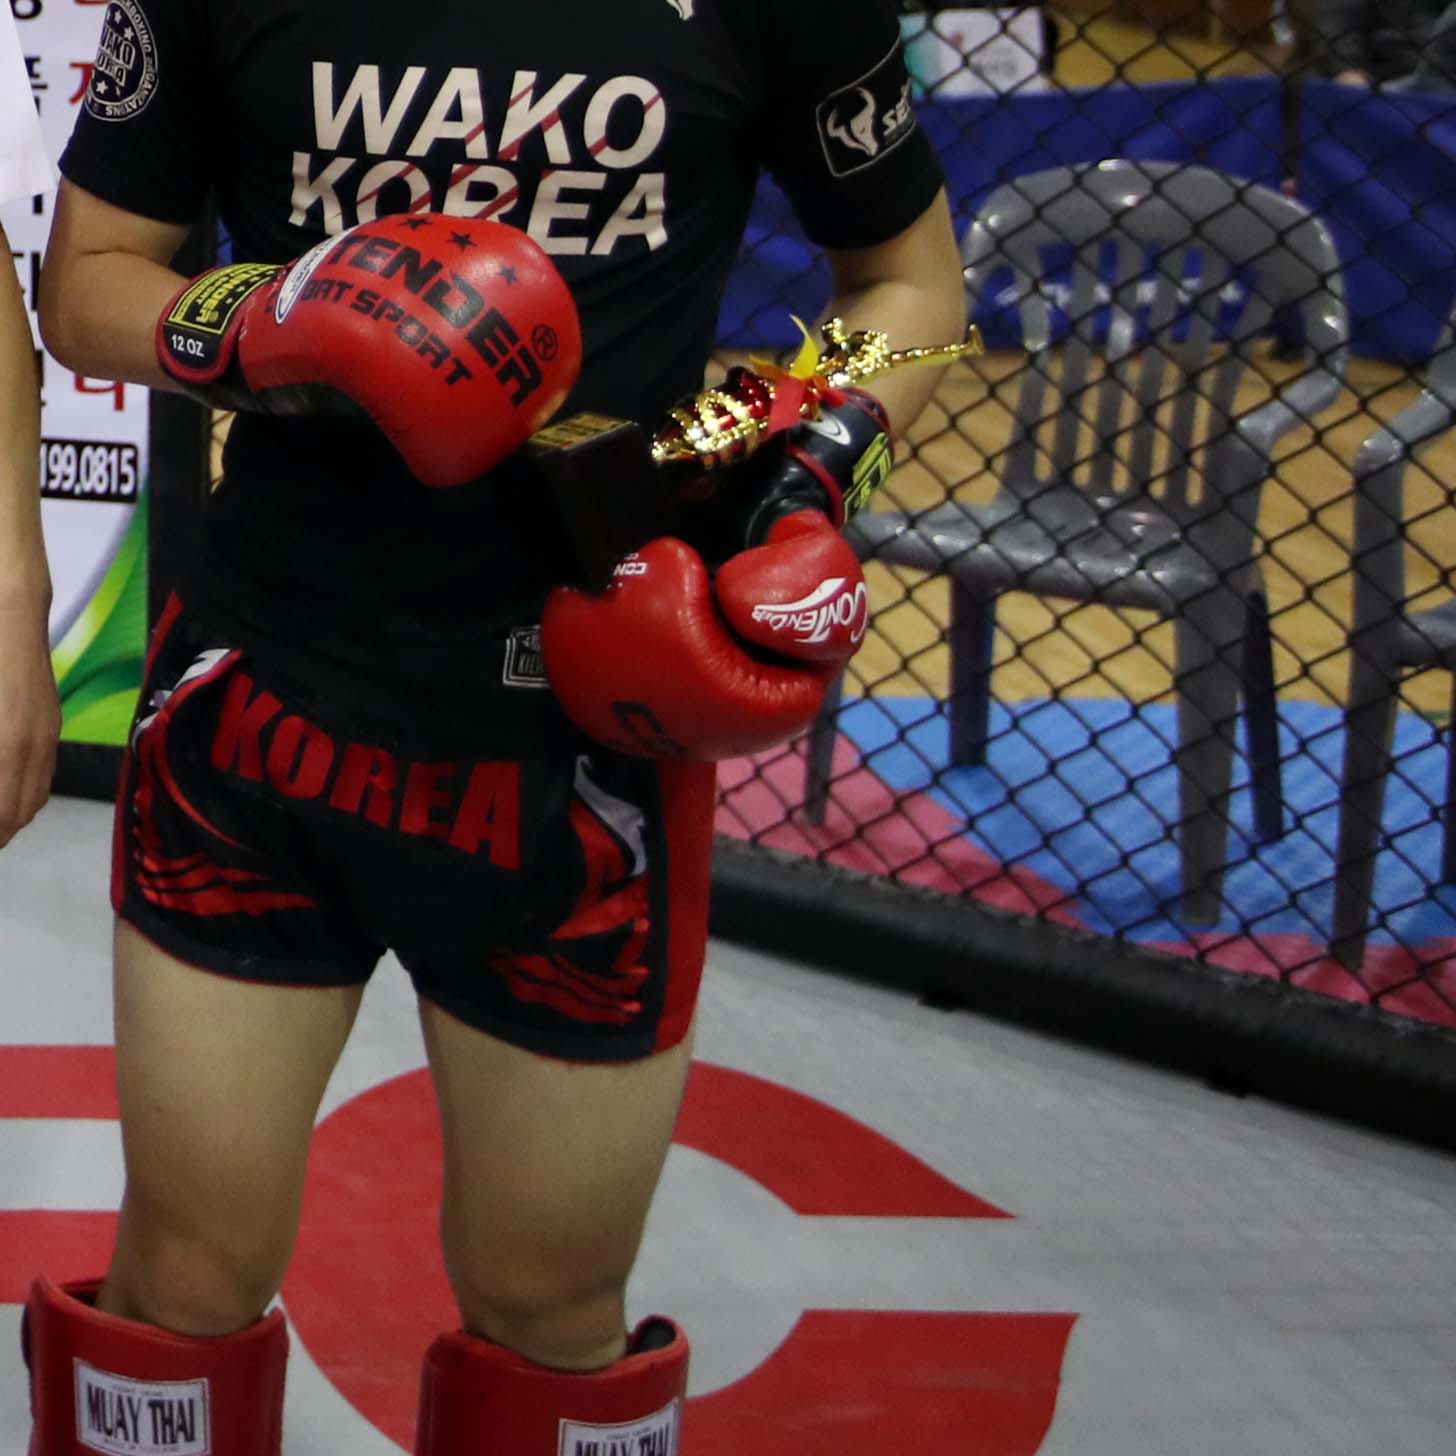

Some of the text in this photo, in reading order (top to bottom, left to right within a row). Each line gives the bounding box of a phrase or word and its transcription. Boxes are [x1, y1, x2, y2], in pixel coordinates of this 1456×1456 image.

[312, 60, 667, 169] WAKO
[289, 151, 668, 255] KOREA
[170, 333, 206, 358] 12 OZ
[351, 288, 475, 386] SPORT
[210, 671, 522, 872] KOREA
[87, 1382, 196, 1445] MUAY THAI
